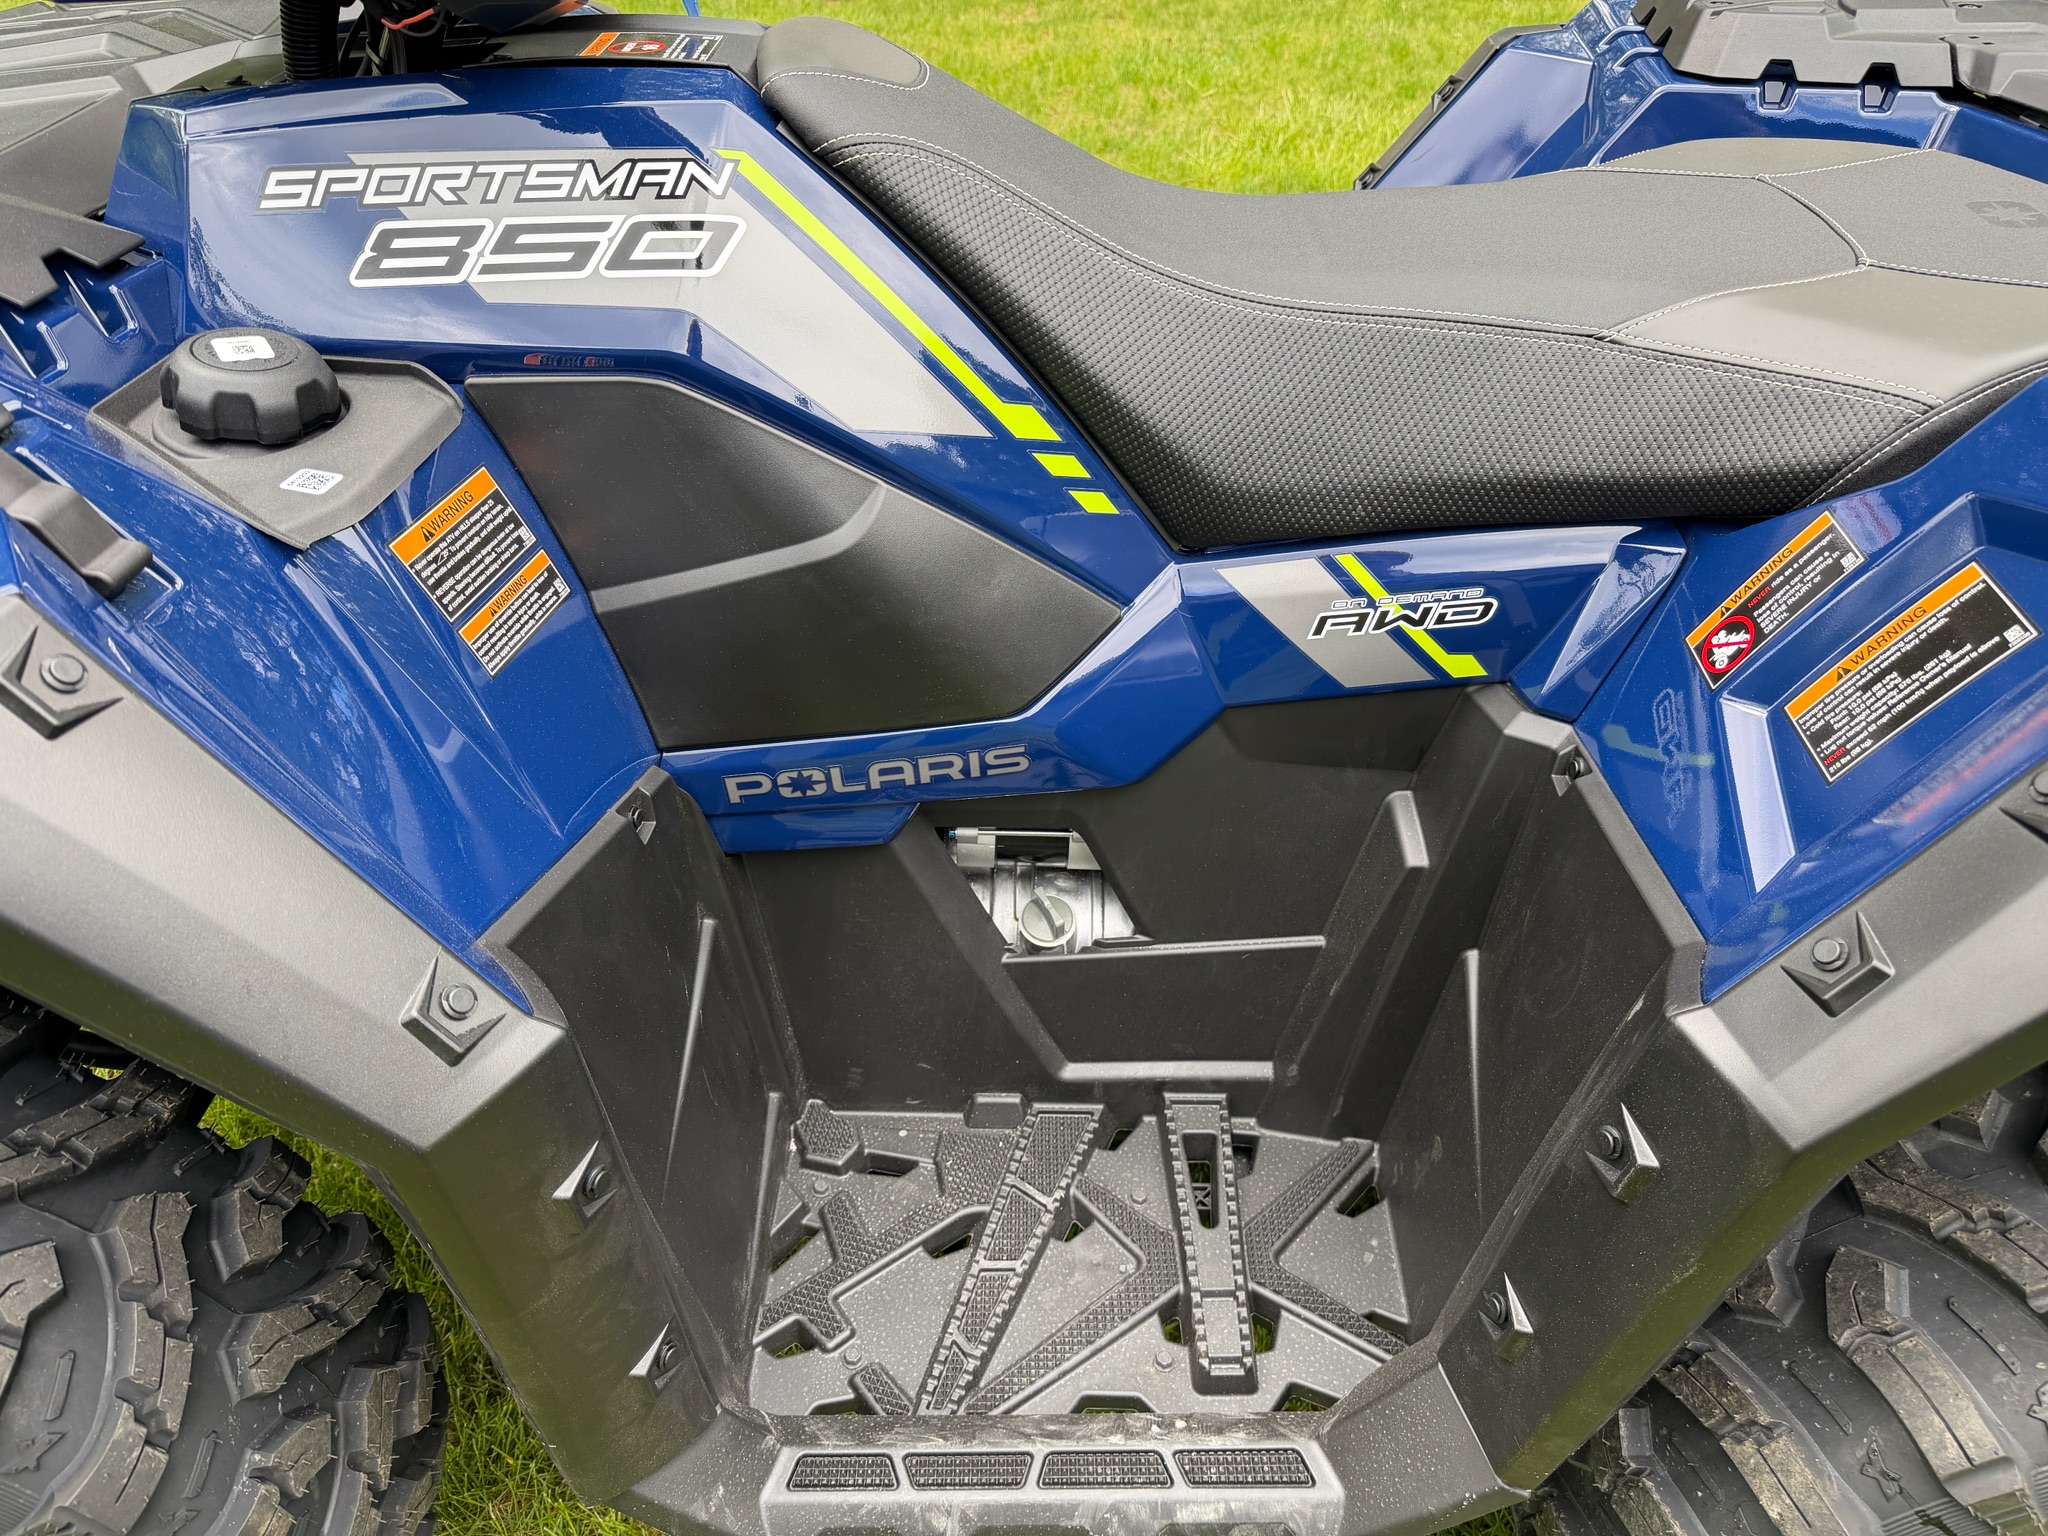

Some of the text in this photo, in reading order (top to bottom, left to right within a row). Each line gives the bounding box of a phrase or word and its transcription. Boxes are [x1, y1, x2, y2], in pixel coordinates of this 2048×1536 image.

[257, 158, 739, 211] SPORTSMAN
[348, 213, 748, 288] 850
[427, 490, 475, 533] WARNING
[457, 519, 471, 533] HILLS
[434, 576, 456, 597] REVERSE
[492, 574, 528, 612] WARNING
[1731, 547, 1793, 604] WARNING
[1747, 586, 1771, 608] NEVER
[1770, 575, 1784, 588] ride
[1783, 567, 1793, 577] as
[1797, 532, 1836, 565] passenger.
[1752, 584, 1791, 618] Passengers
[1789, 573, 1804, 586] can
[1802, 555, 1824, 575] cause
[1756, 609, 1771, 623] loss
[1770, 601, 1779, 611] of
[1778, 582, 1804, 604] control,
[1802, 556, 1833, 586] resulting
[1831, 550, 1841, 559] in
[1307, 598, 1499, 640] AWD
[1331, 587, 1486, 610] ON DEMAND
[1759, 574, 1821, 628] SEVERE INJURY or
[1763, 611, 1790, 634] DEATH.
[1798, 582, 1986, 725] Improper tire pressure or overloading can cause loss of control.
[1850, 606, 1927, 666] WARNING
[1801, 617, 1949, 730] Loss of control can result in severe injury or death.
[1820, 724, 1850, 749] Maximum
[1848, 708, 1871, 727] weight
[1869, 687, 1899, 711] capacity:
[1910, 670, 1925, 681] lbs.
[1937, 649, 1952, 661] kg)
[1823, 642, 1972, 755] Lug nut torque values: Reference Owner's Manual
[1823, 746, 1846, 766] NEVER
[1845, 729, 1869, 749] exceed
[1867, 722, 1877, 732] 62
[1875, 712, 1892, 726] mph
[1890, 701, 1906, 716] (100
[1904, 687, 1926, 705] km/h)
[1923, 675, 1944, 690] when
[1942, 654, 1971, 678] payload
[1968, 650, 1978, 658] is
[1976, 635, 2000, 653] above
[1829, 709, 1849, 725] Front:
[1847, 697, 1862, 710] 10.0
[1861, 689, 1873, 701] psi
[1881, 670, 1898, 685] kPa)
[1809, 689, 1863, 732] Cold tire pressure:
[1832, 715, 1851, 730] Rear:
[1851, 702, 1866, 716] 10.0
[1864, 695, 1877, 707] psi
[1885, 676, 1902, 690] kPa)
[724, 744, 1033, 804] POLARIS
[1839, 754, 1851, 765] lbs
[1859, 738, 1874, 749] kg).
